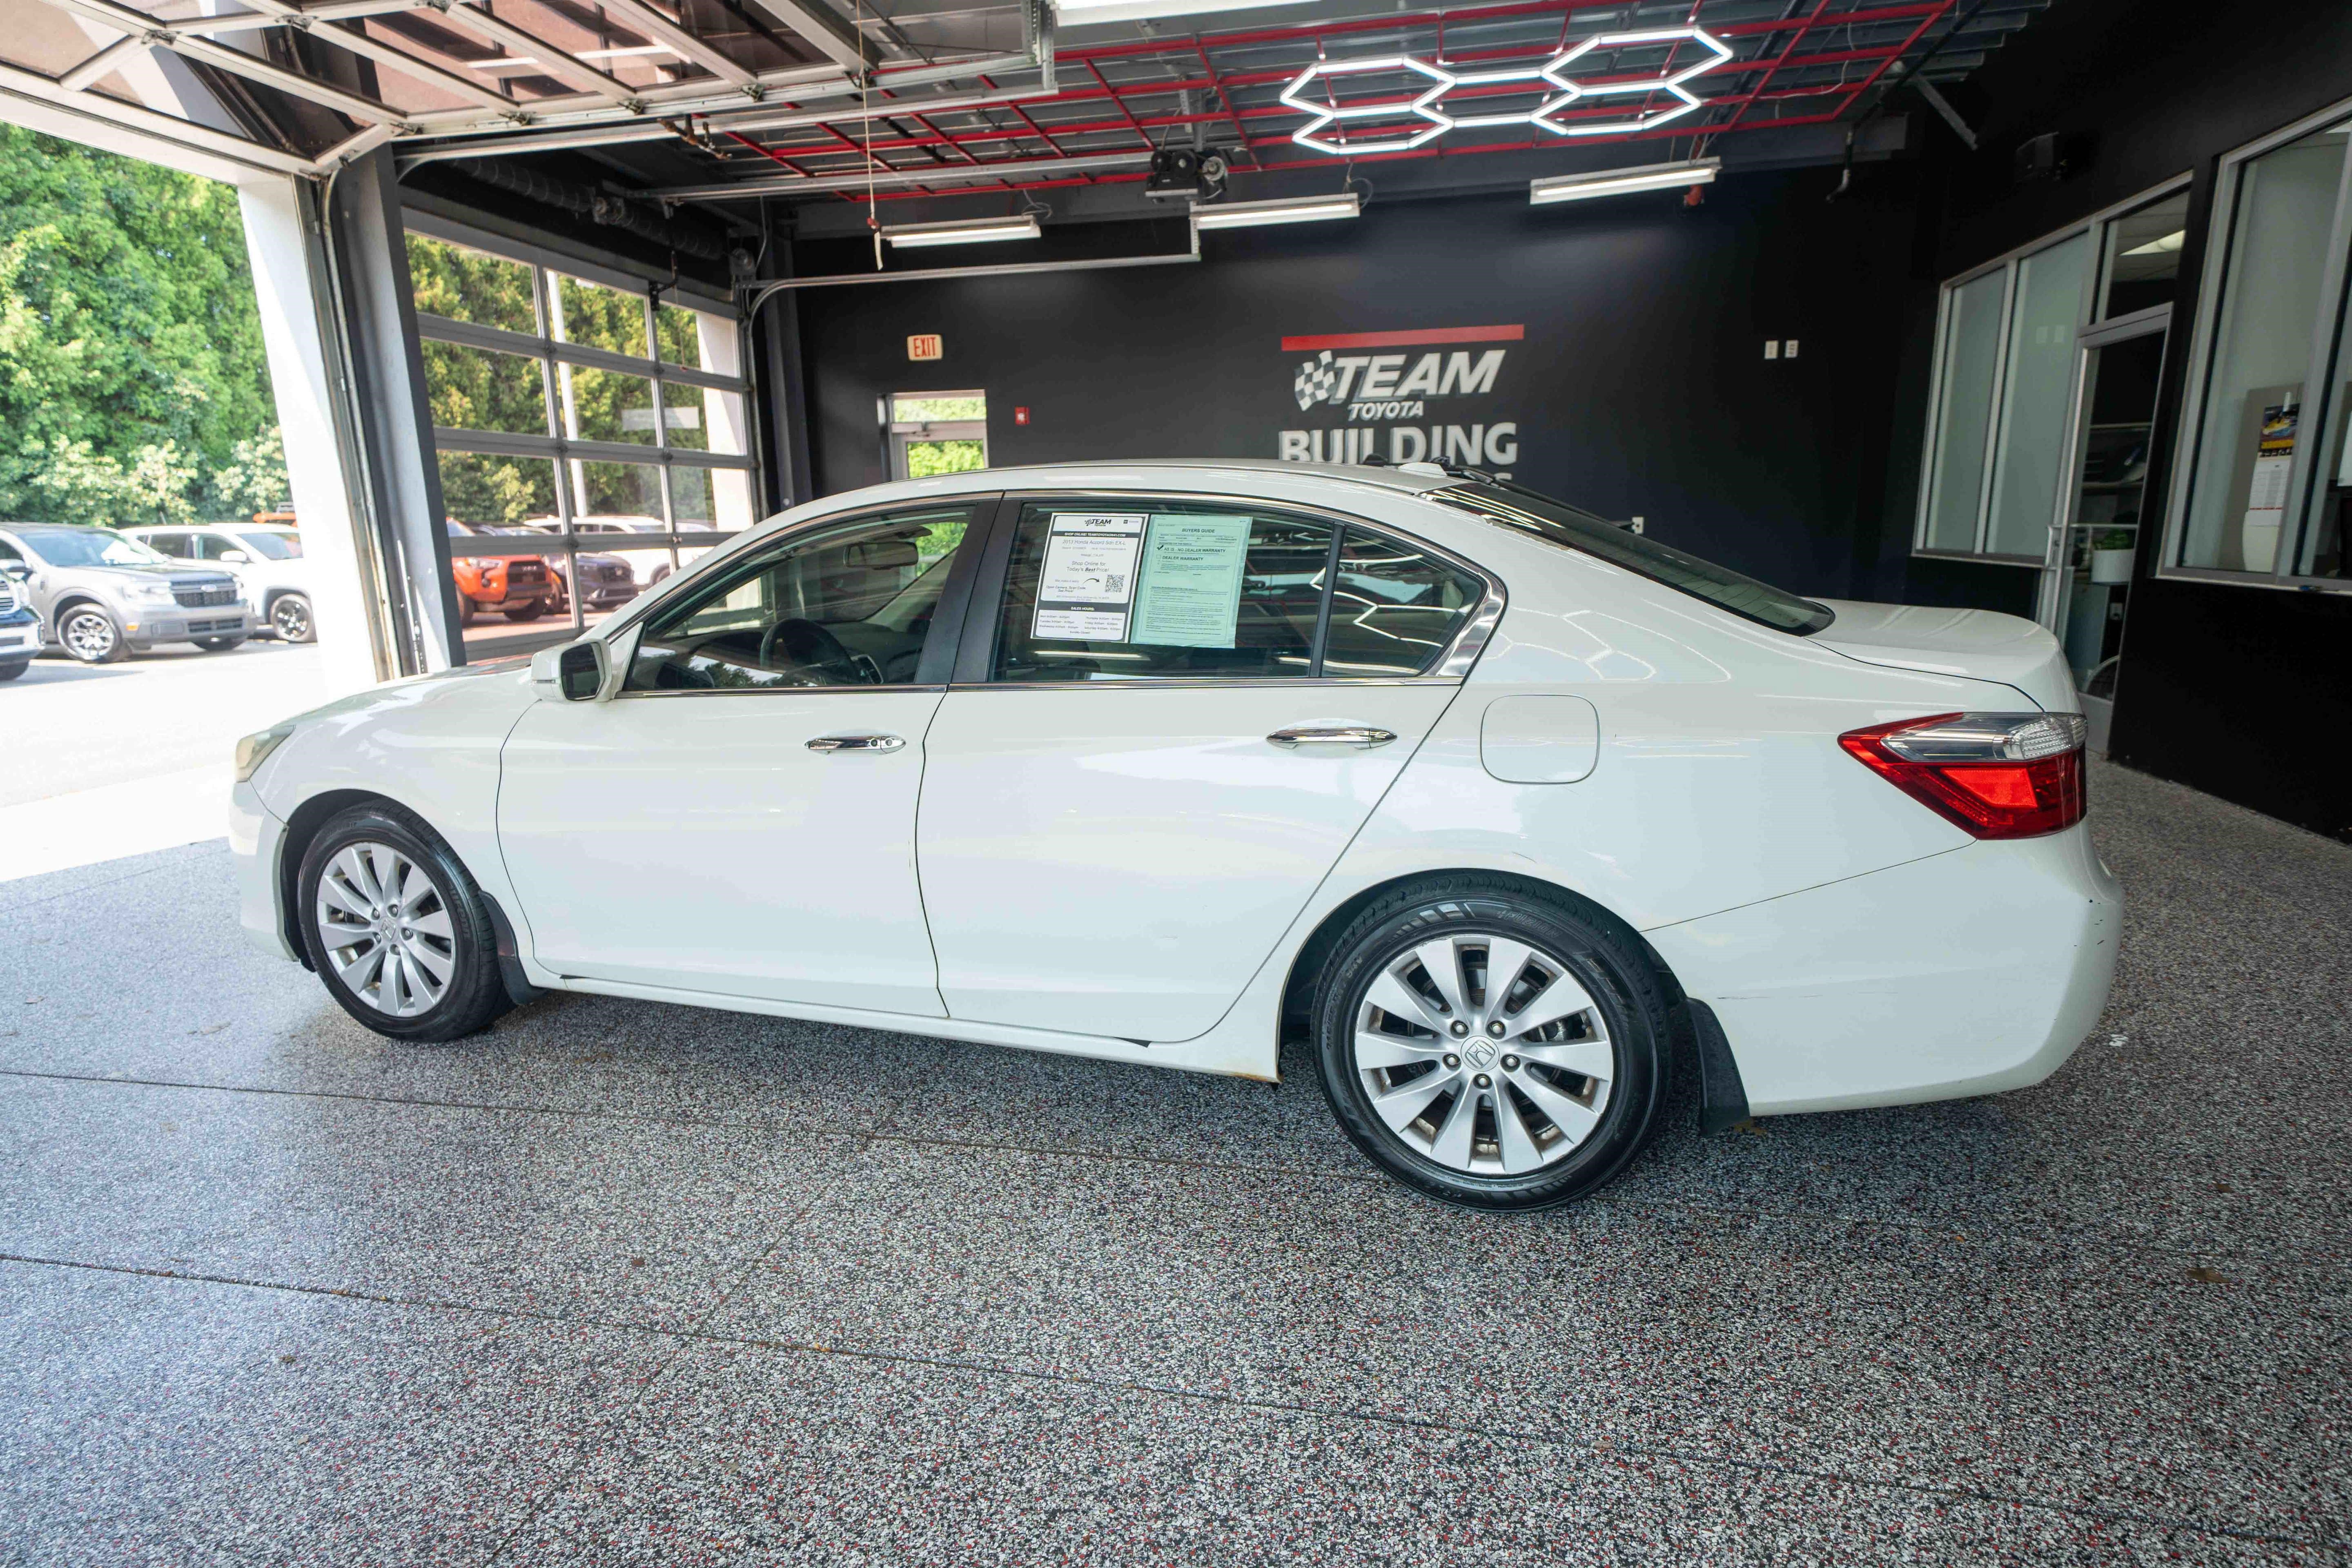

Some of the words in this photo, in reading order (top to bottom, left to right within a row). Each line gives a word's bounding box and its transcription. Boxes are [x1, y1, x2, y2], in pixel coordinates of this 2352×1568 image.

[913, 337, 935, 357] EXIT
[1330, 350, 1506, 402] TEAM
[1348, 401, 1423, 421] TOYOTA
[1279, 422, 1517, 466] BUILDING
